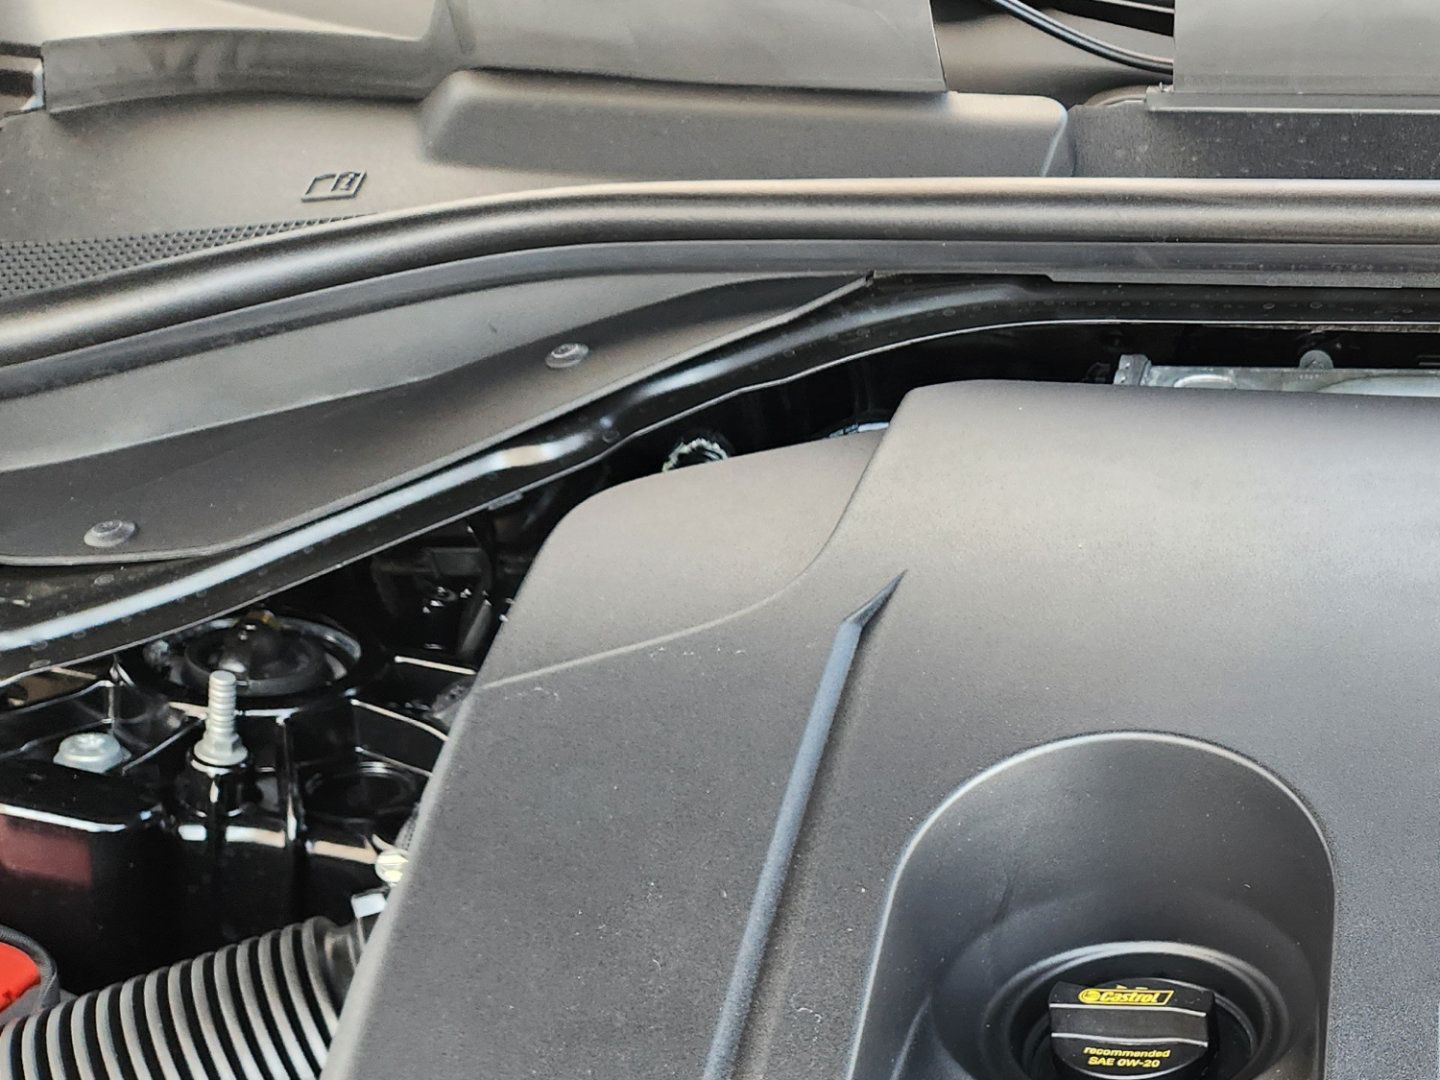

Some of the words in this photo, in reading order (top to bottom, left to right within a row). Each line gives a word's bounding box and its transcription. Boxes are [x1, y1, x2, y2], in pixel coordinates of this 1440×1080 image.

[1100, 991, 1161, 1003] Castrol
[1083, 1047, 1171, 1058] recommended
[1088, 1057, 1115, 1066] SAE
[1117, 1058, 1160, 1068] 0W-20
